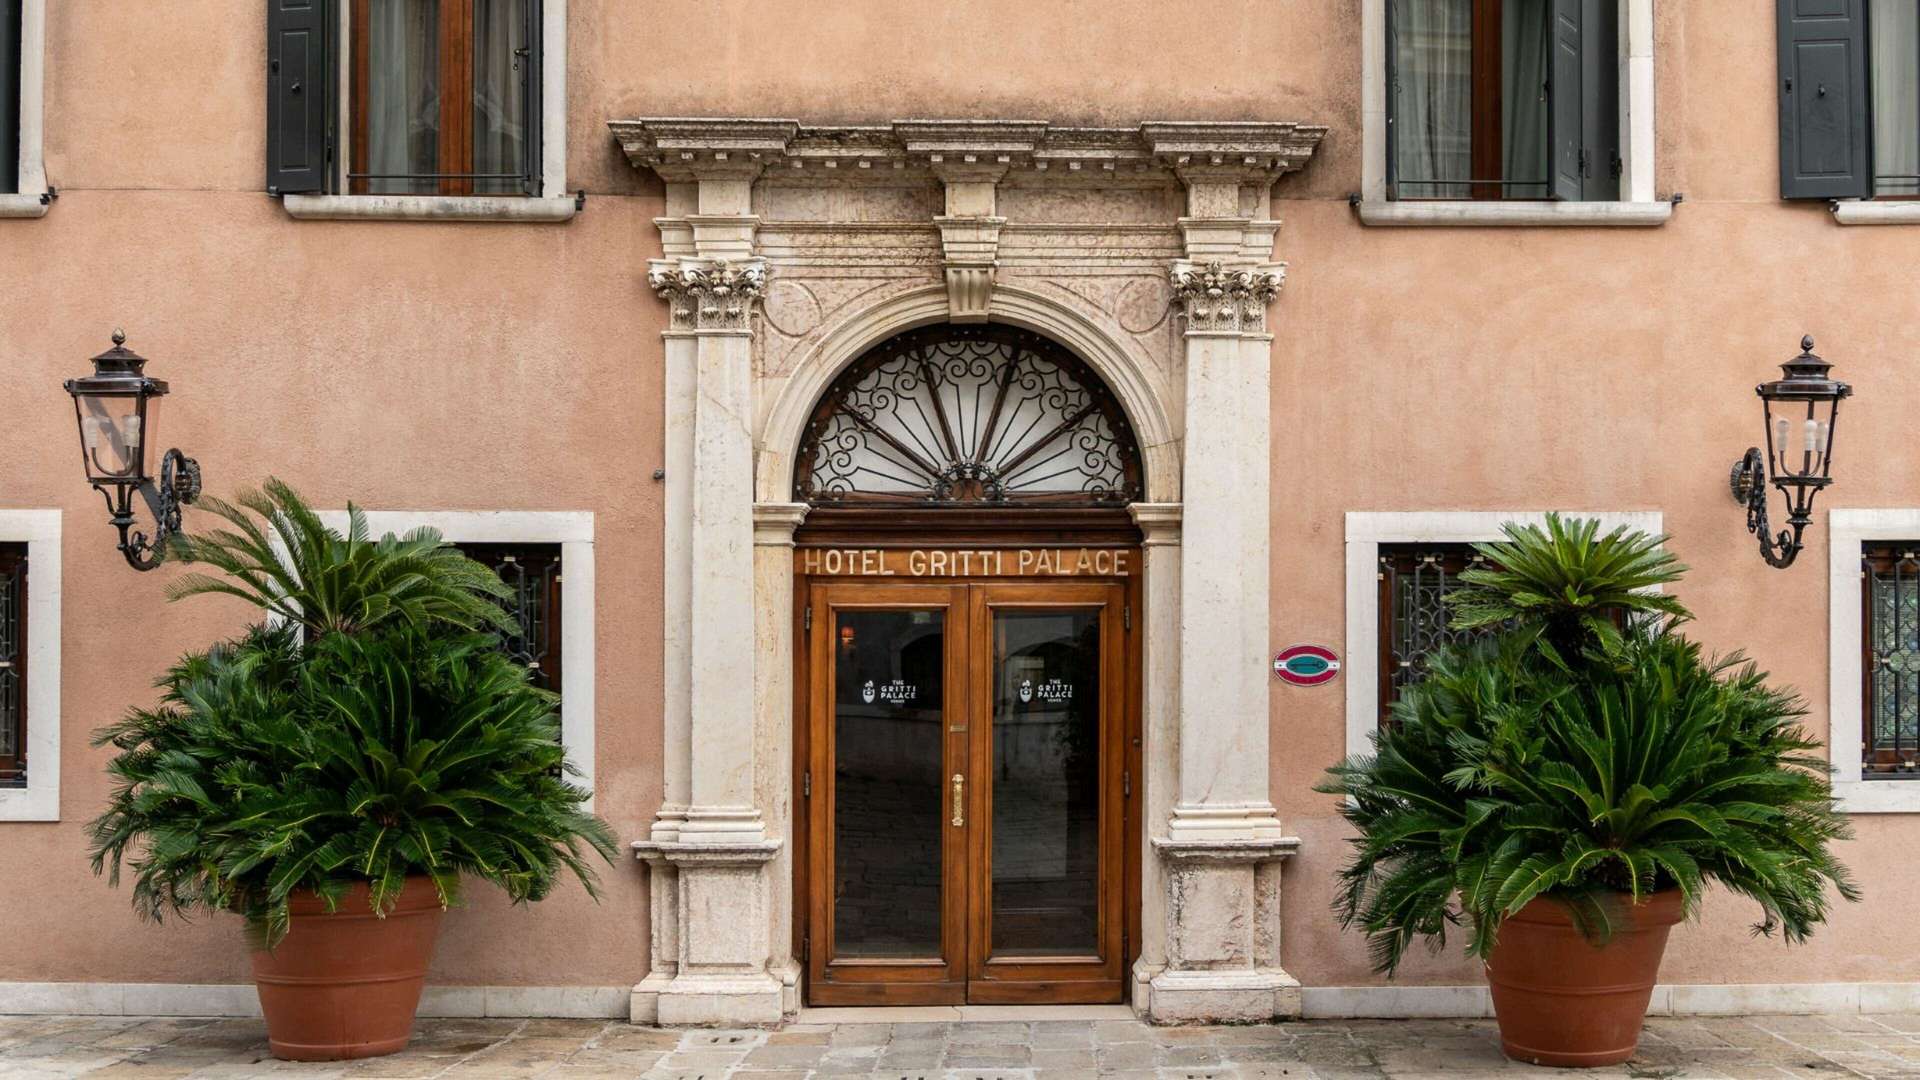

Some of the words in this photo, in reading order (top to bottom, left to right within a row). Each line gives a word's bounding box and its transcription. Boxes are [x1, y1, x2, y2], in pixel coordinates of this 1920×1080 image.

[805, 549, 895, 575] HOTEL
[909, 550, 1001, 576] GRITTI
[1019, 548, 1129, 576] PALACE
